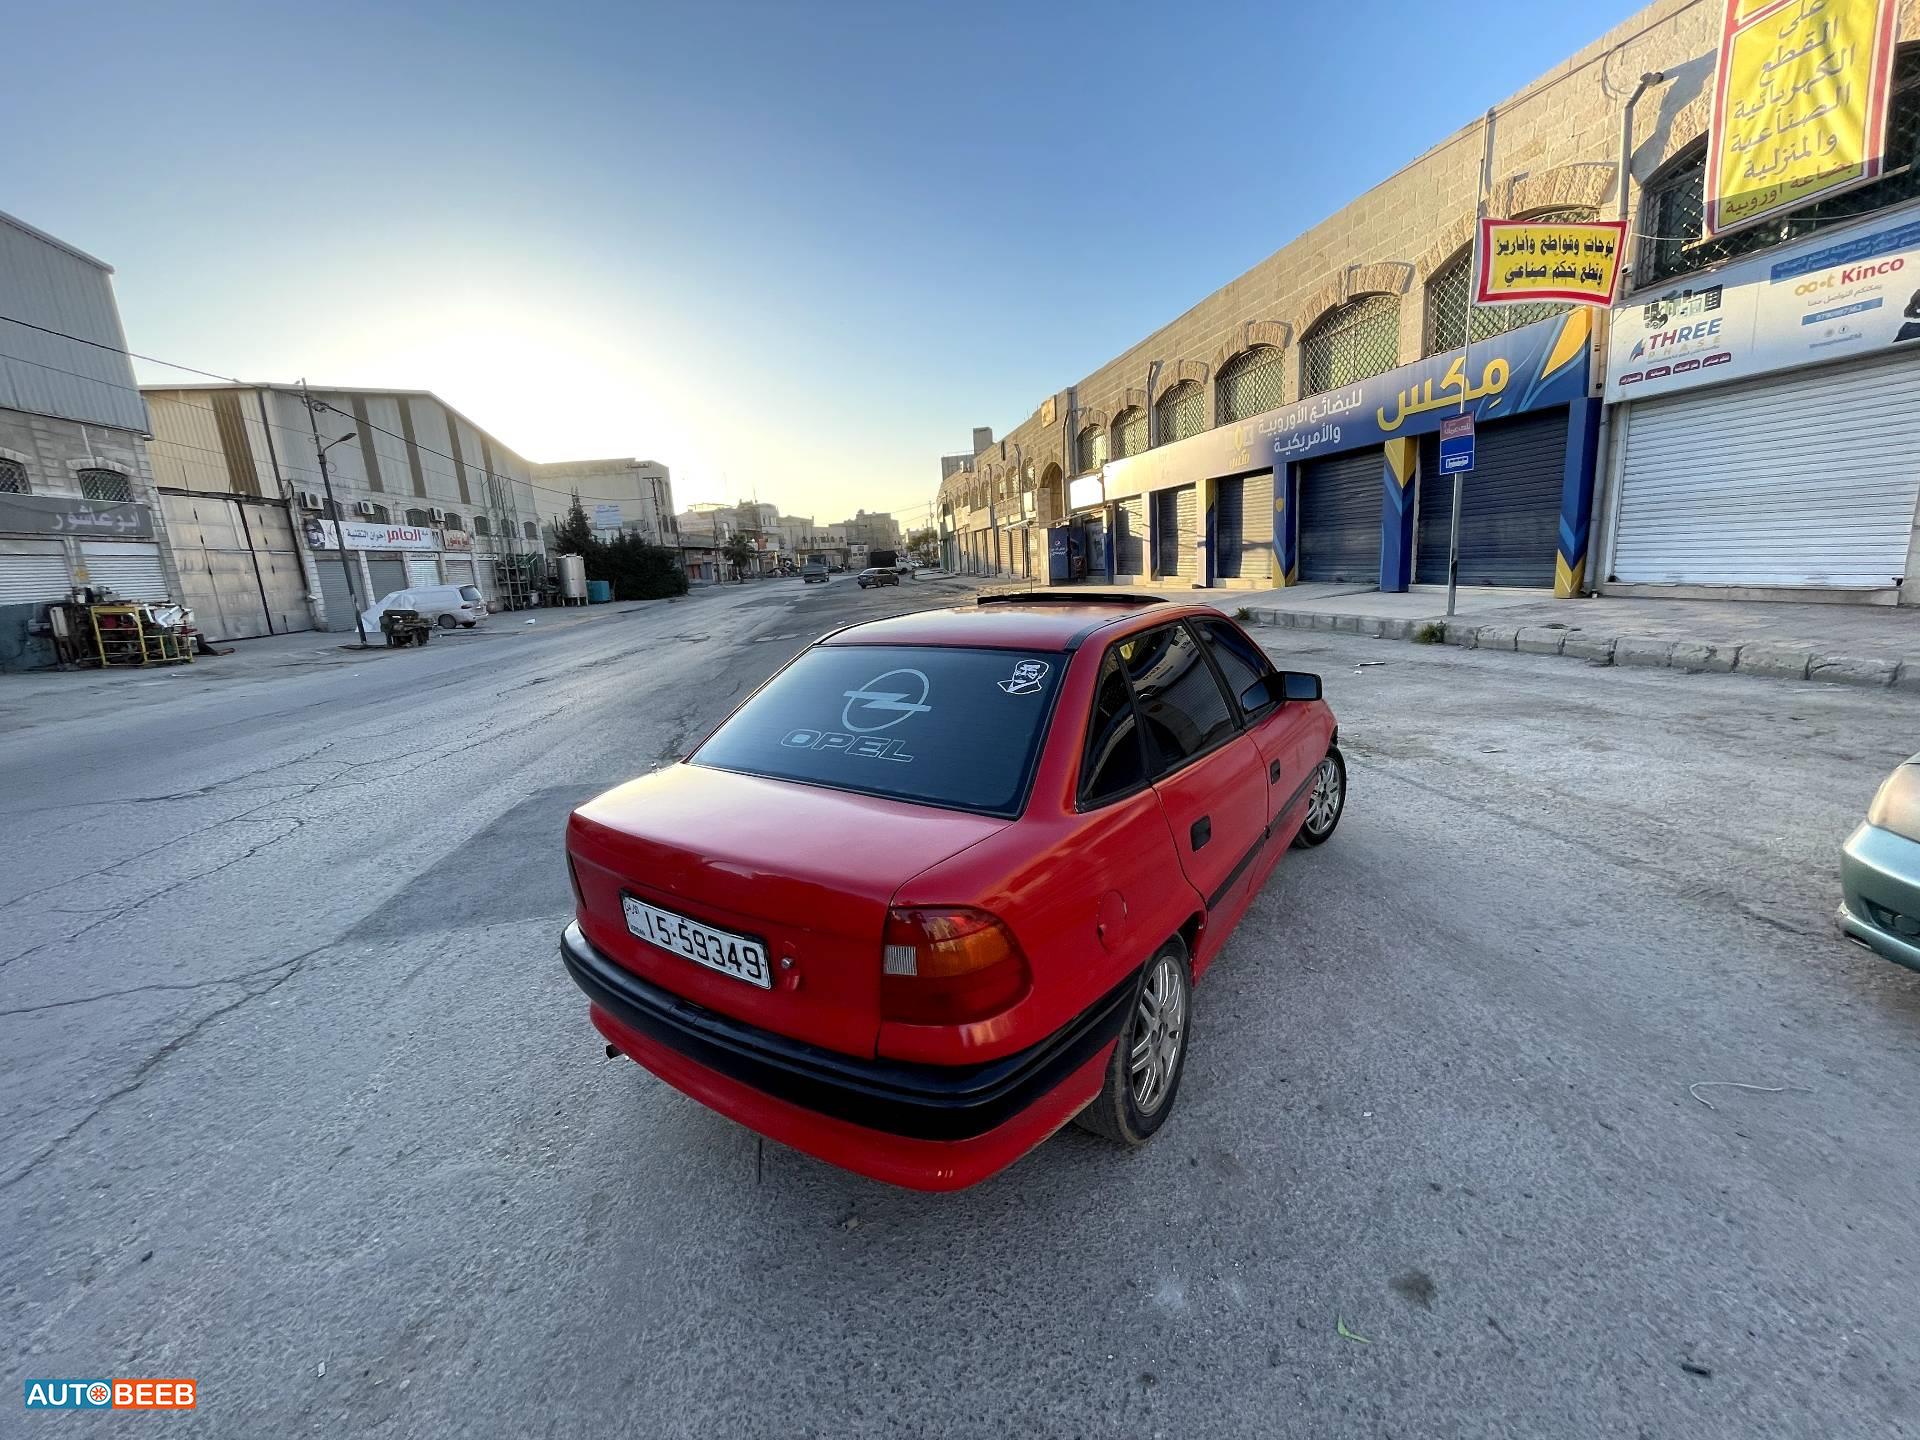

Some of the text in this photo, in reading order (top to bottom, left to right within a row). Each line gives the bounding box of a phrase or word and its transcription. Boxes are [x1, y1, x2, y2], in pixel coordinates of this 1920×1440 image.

[1759, 16, 1838, 87] القطع
[1733, 42, 1855, 121] الكهربائية
[1731, 82, 1850, 155] الصناعية
[1744, 129, 1837, 182] والمنزلية
[1790, 160, 1854, 188] بضاعة
[1540, 234, 1580, 256] وقواطع
[1584, 235, 1615, 258] لوحات
[1552, 260, 1577, 284] تحكم
[1580, 262, 1603, 286] وقطع
[1841, 258, 1905, 285] Kinco
[1649, 317, 1723, 350] THREE
[1259, 388, 1363, 436] للبضائع الأوروبية
[1273, 422, 1341, 456] والأمريكية
[780, 728, 914, 763] OPEL
